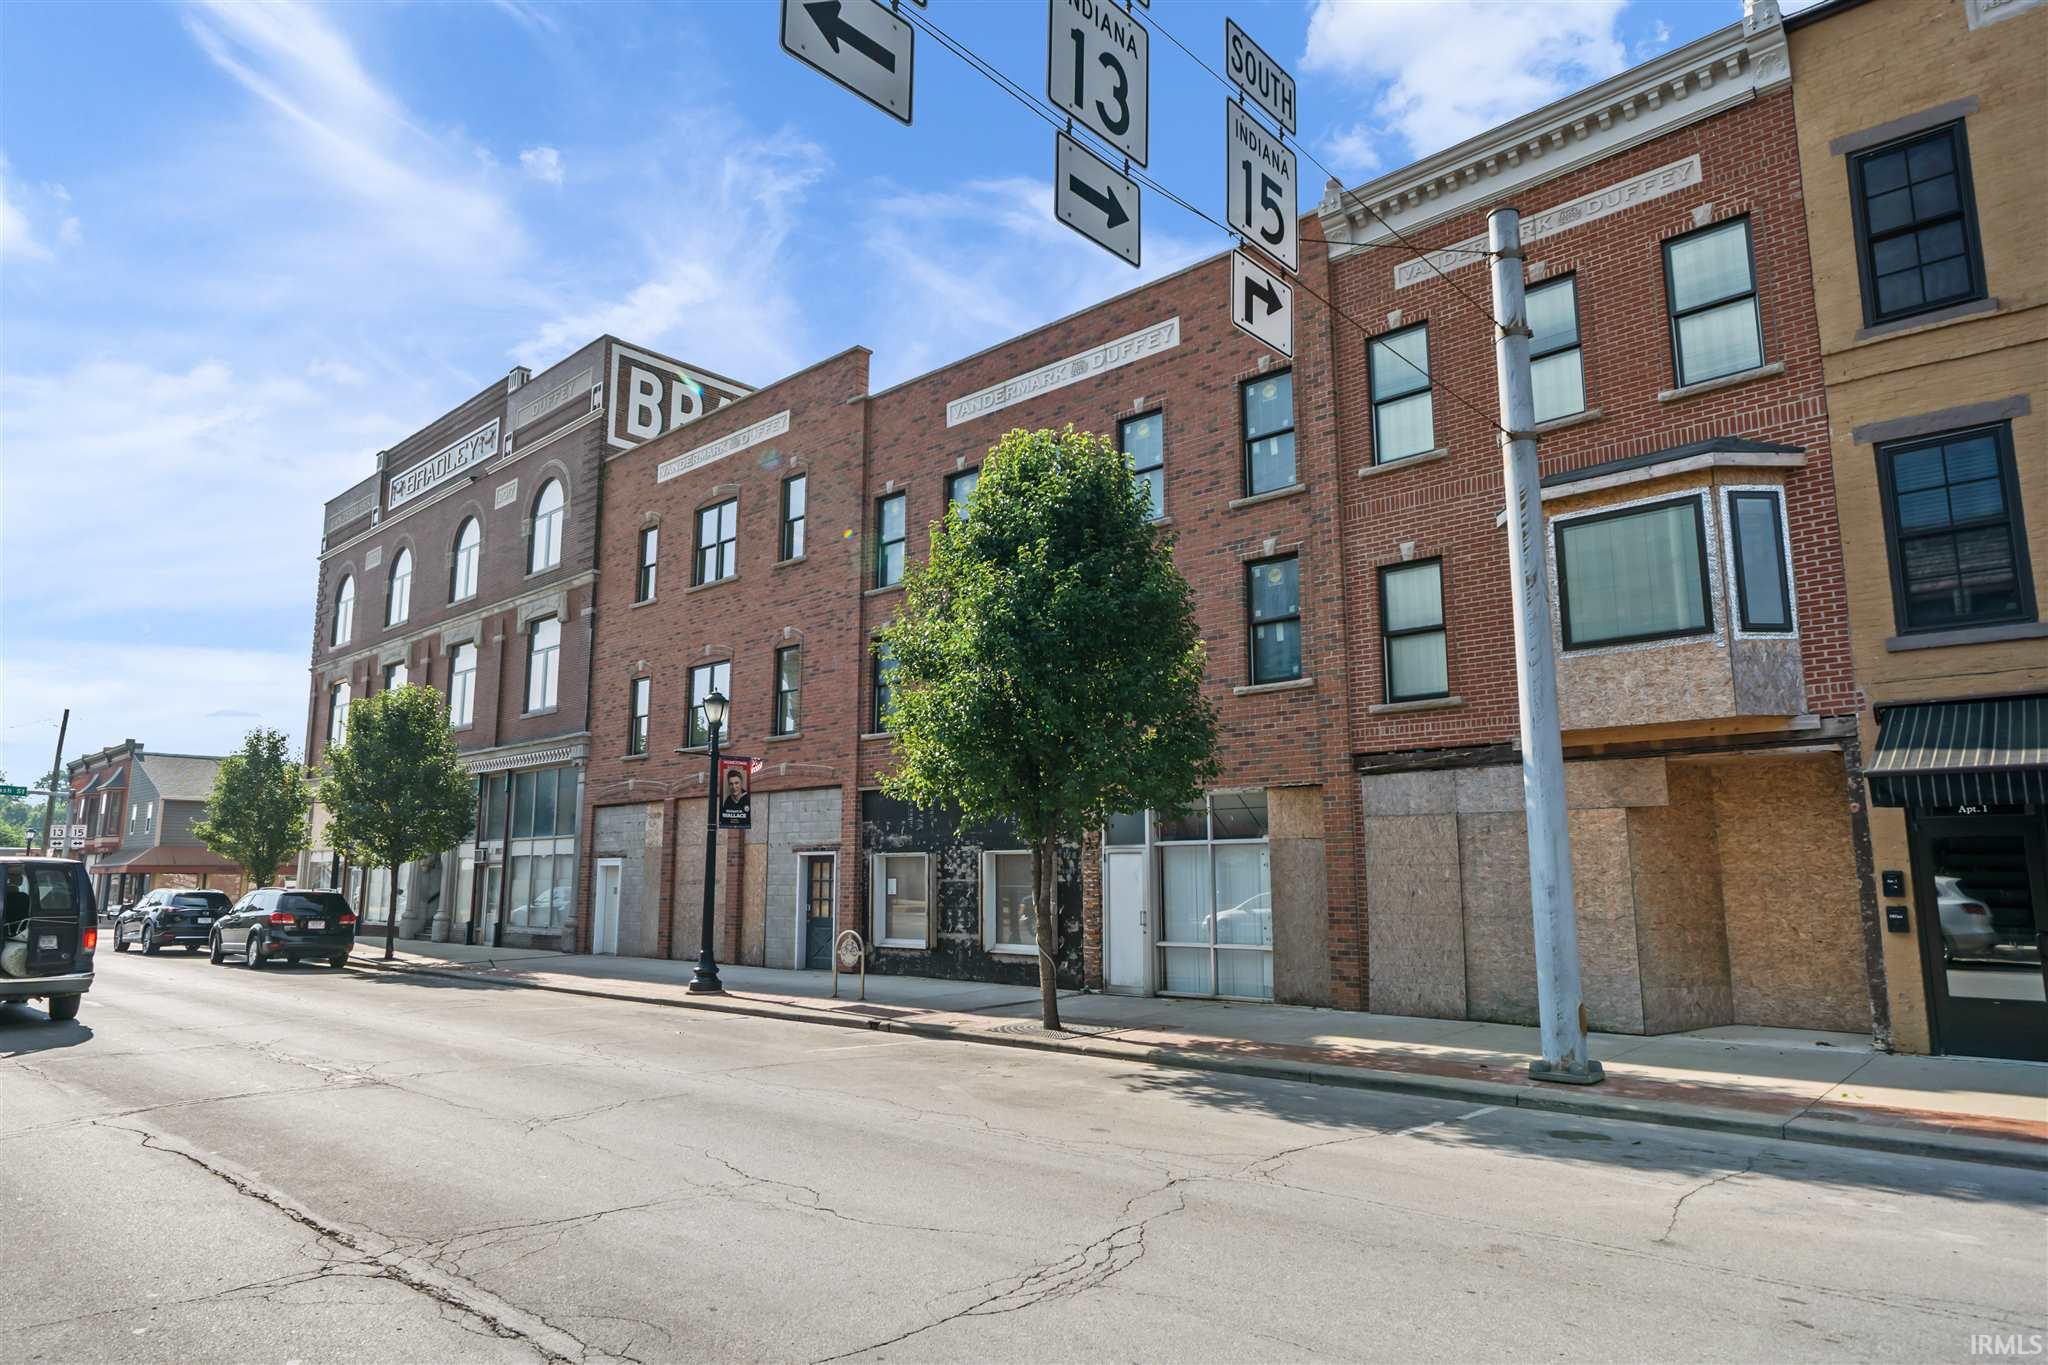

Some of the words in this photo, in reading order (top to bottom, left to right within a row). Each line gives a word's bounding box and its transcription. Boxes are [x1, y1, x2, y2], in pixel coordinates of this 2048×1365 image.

[1070, 28, 1131, 136] 13
[1231, 34, 1293, 121] SOUTH
[1235, 118, 1290, 181] INDIANA
[1241, 160, 1285, 245] 15
[1402, 216, 1554, 281] VANDERRK
[1587, 163, 1694, 215] DUFFEY
[530, 383, 577, 417] DUFFEY
[627, 365, 734, 440] BR
[952, 365, 1067, 419] VANDERMARK
[1092, 323, 1176, 370] DUFFEY
[407, 436, 480, 495] BRADLEY
[660, 441, 729, 479] VANDERMARK
[740, 417, 788, 446] DUFFEY
[53, 828, 64, 836] 13
[73, 828, 84, 836] 15
[1958, 805, 1981, 815] Apt.
